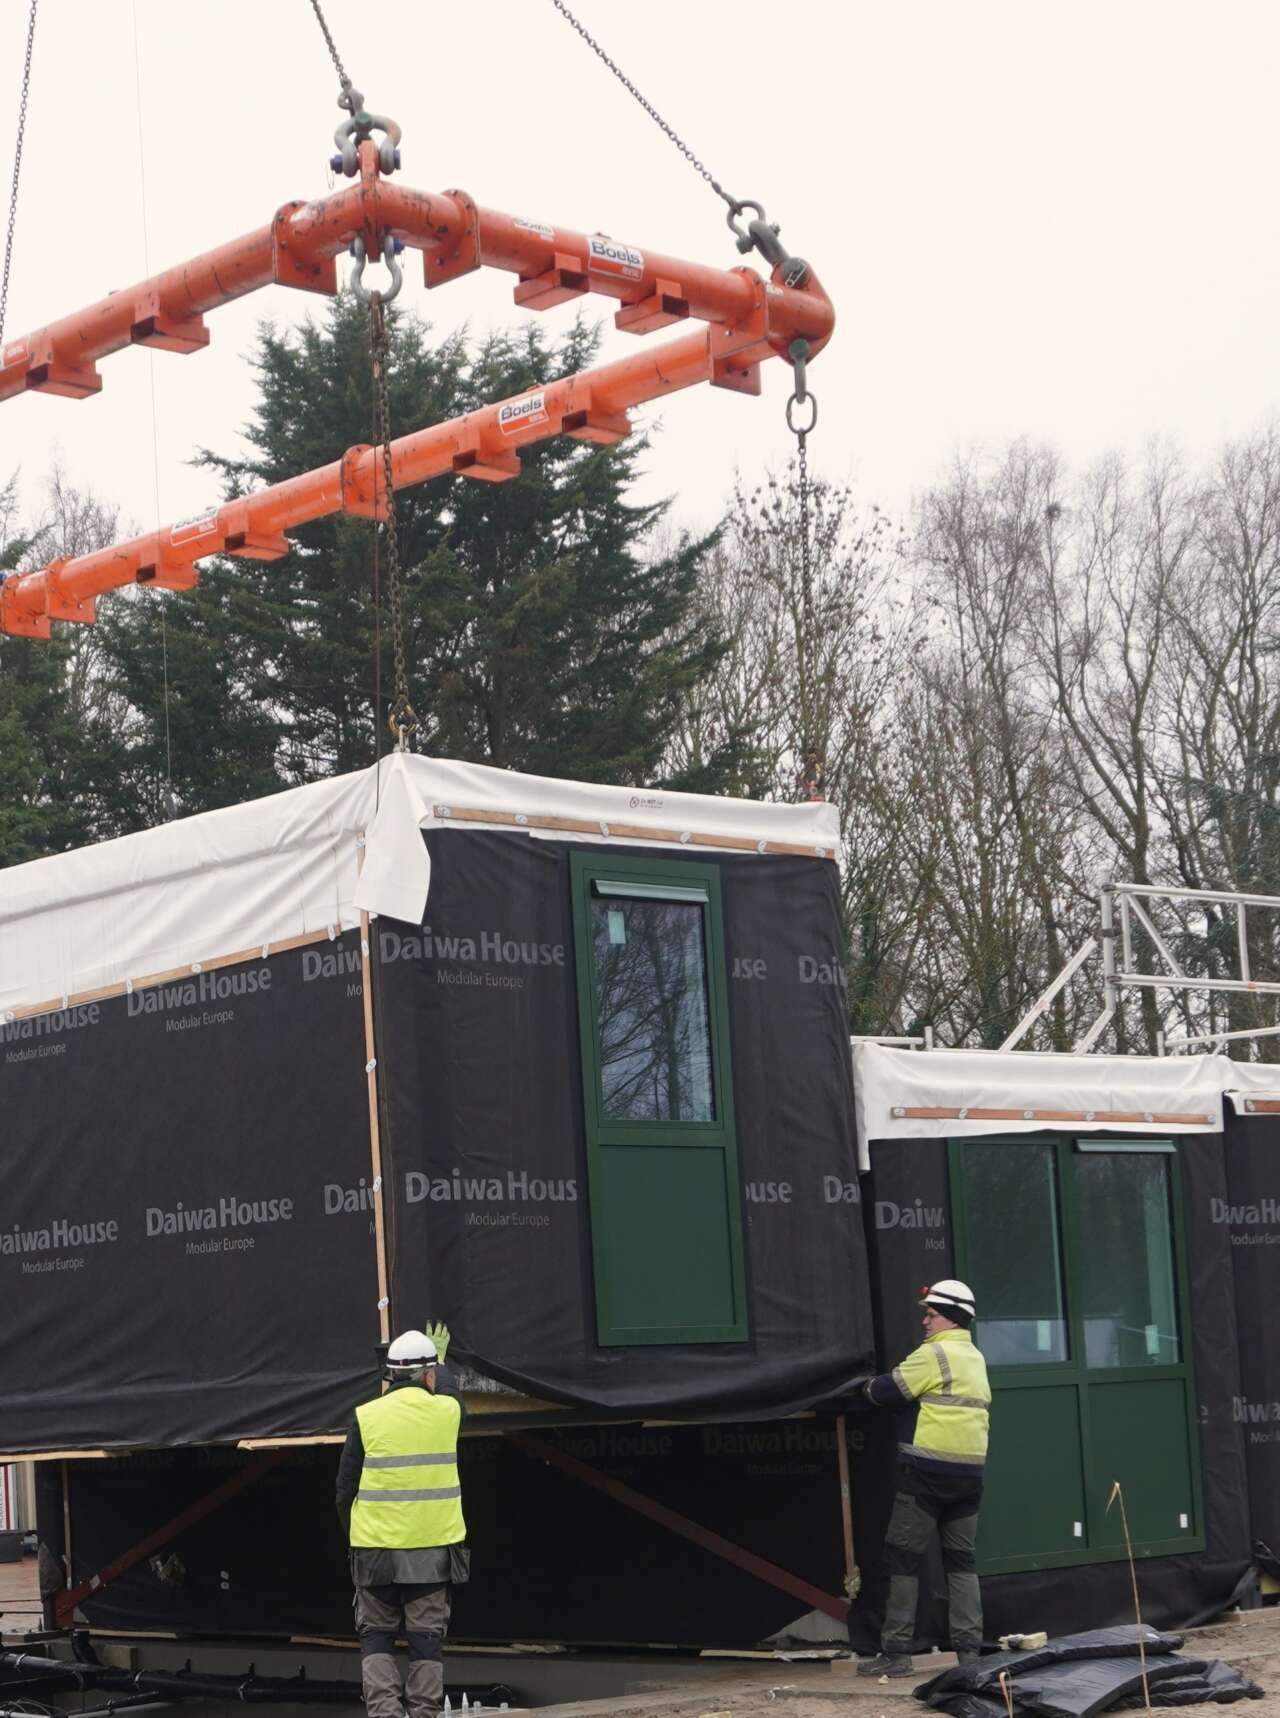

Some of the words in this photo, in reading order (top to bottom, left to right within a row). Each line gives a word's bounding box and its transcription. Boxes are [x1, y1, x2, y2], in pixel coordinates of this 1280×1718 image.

[591, 241, 641, 264] Boels
[501, 399, 542, 420] Boels
[436, 969, 483, 986] Modular
[484, 972, 525, 990] Europe
[166, 1014, 202, 1032] Modular
[202, 1009, 234, 1025] Europe
[465, 1212, 510, 1226] Modular
[511, 1213, 551, 1228] Europe
[875, 1198, 945, 1230] Daiw
[185, 1238, 223, 1255] Modular
[223, 1235, 255, 1251] Europe
[21, 1259, 55, 1274] Modular
[56, 1256, 85, 1271] Europe
